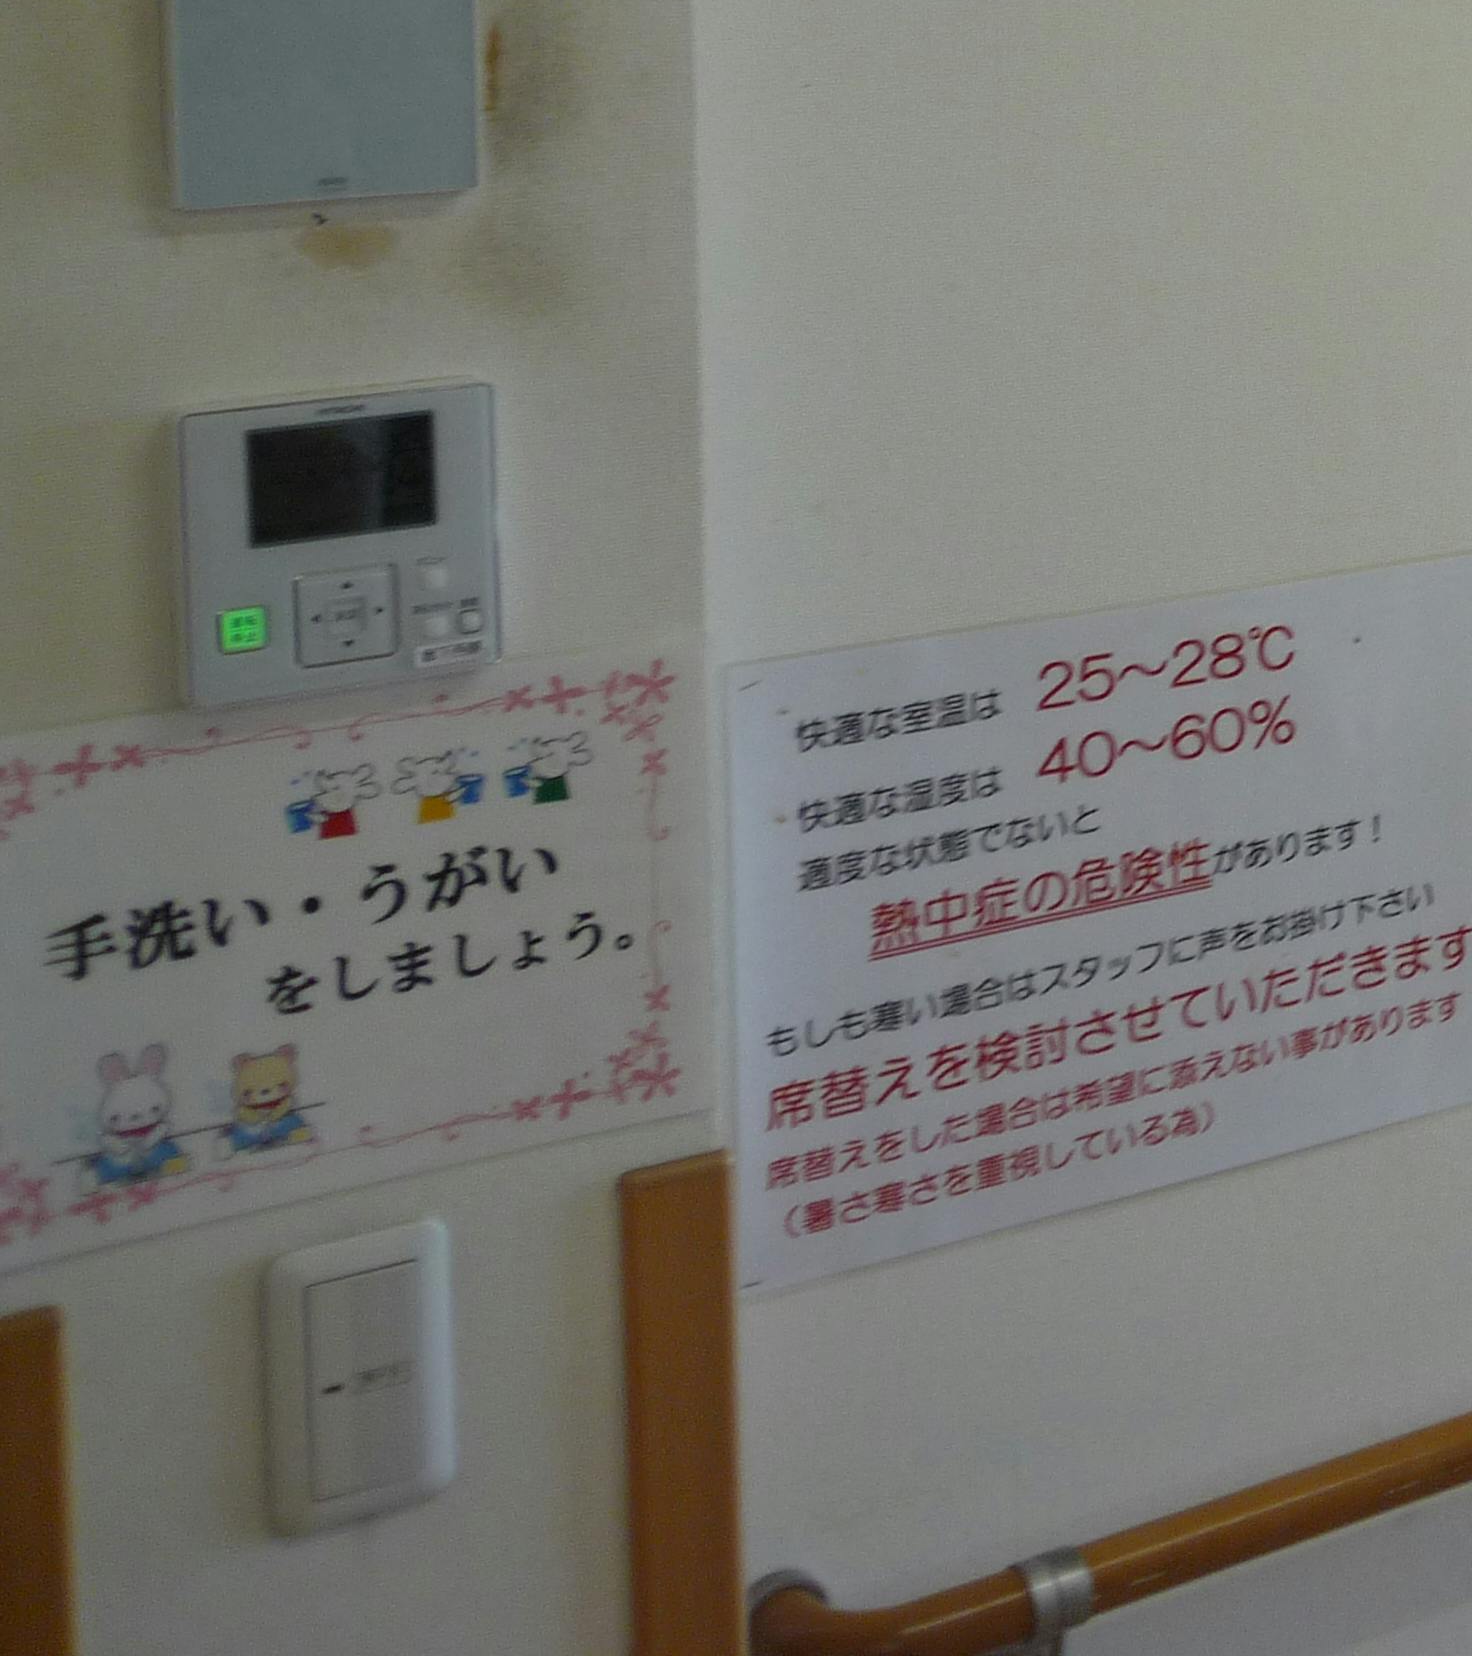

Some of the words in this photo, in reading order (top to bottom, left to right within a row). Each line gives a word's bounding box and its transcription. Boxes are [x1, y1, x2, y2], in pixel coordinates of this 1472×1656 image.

[795, 688, 1003, 753] 快適な室温は
[797, 766, 1003, 833] 快適な湿度は
[798, 805, 1101, 893] 適度な状態でないと
[43, 846, 560, 981] 手洗い・うがい
[266, 911, 635, 1015] をしましょう。
